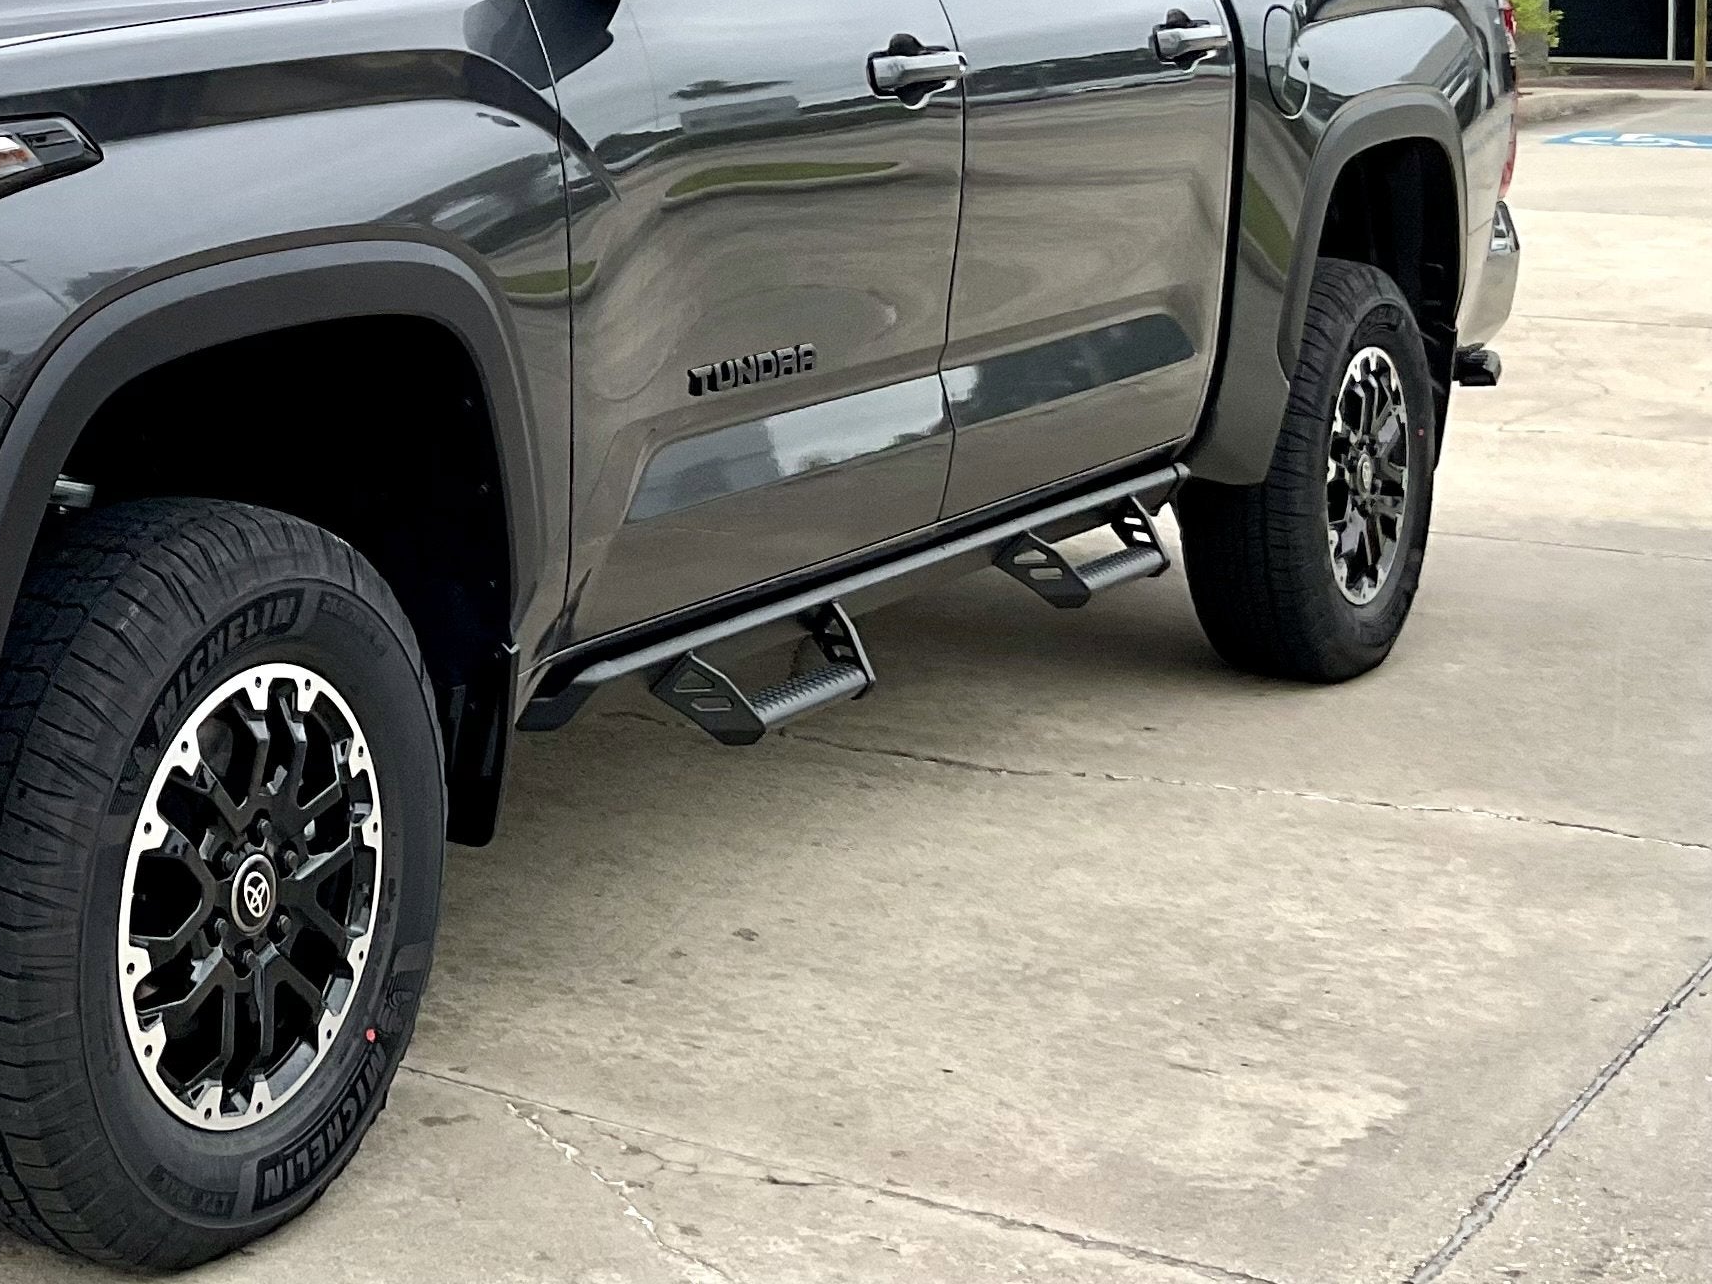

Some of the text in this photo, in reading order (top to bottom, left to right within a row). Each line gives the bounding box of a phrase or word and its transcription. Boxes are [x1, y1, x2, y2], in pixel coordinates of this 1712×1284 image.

[688, 342, 818, 396] TUNDRA
[152, 595, 298, 742] MICHELIN
[262, 1043, 389, 1201] MICHELIN
